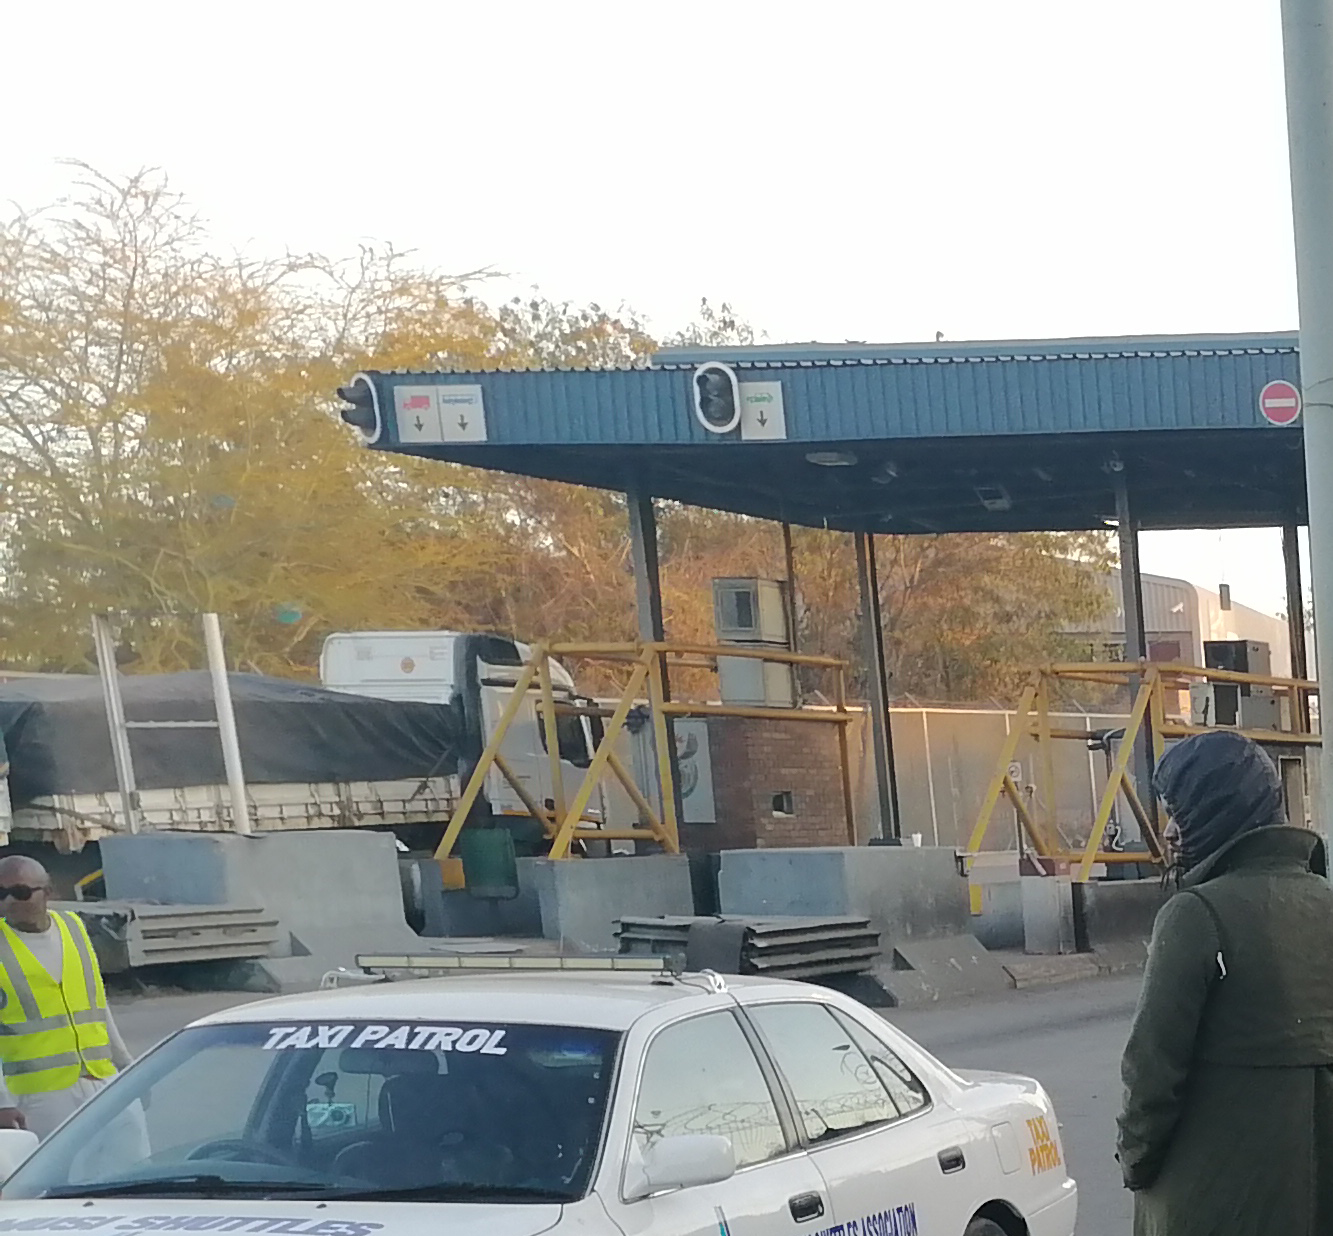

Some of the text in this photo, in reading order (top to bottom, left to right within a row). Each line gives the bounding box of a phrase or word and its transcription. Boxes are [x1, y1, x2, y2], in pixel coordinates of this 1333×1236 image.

[262, 1025, 507, 1055] TAXI PATROL
[1026, 1115, 1050, 1146] TAXI
[1028, 1140, 1061, 1176] PATROL
